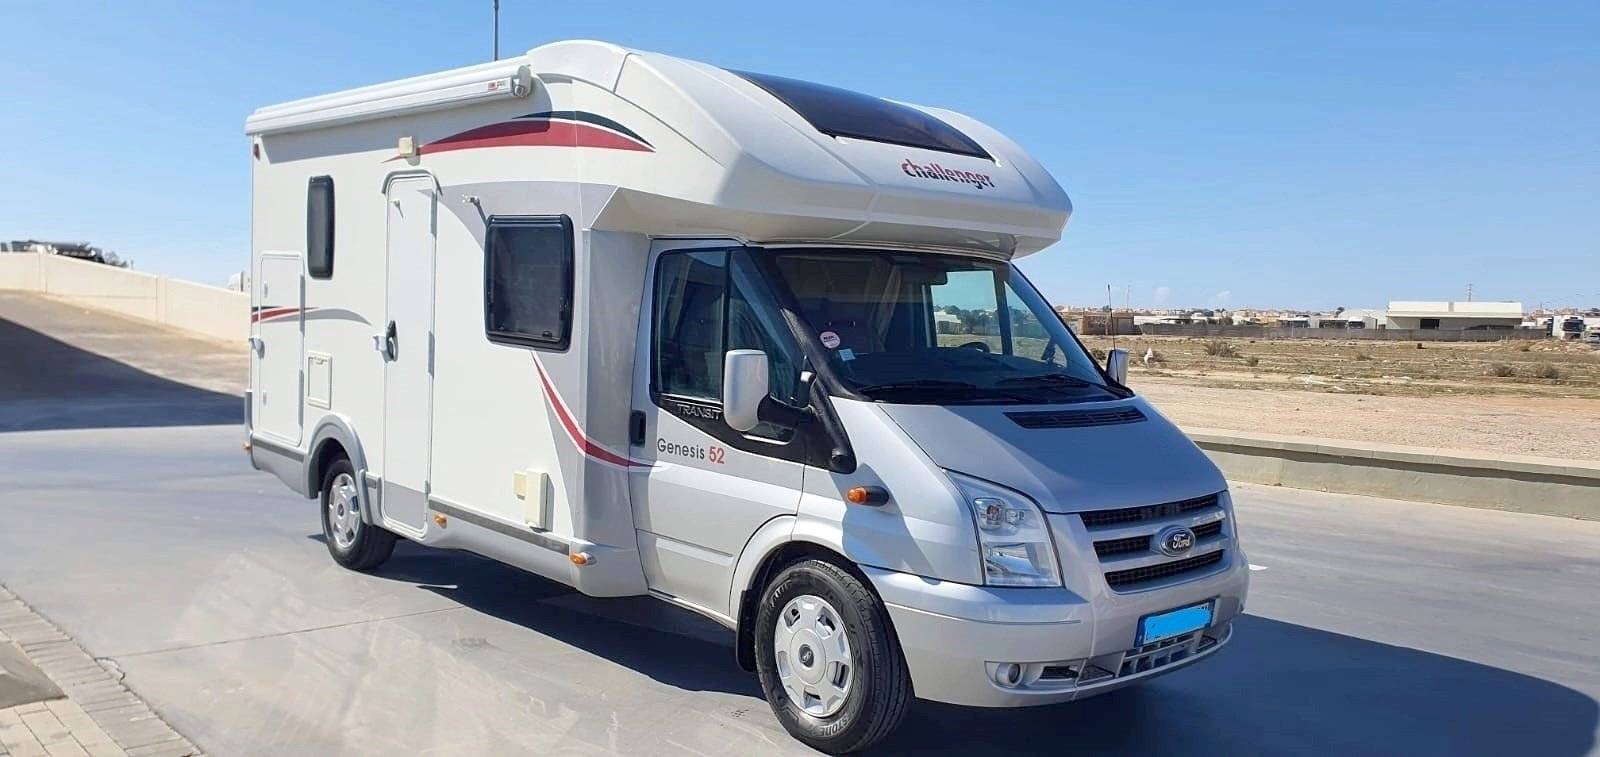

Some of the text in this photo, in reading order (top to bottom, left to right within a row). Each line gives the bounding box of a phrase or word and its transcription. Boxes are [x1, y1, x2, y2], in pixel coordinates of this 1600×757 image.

[901, 158, 995, 190] challenger
[677, 403, 722, 420] TRANSIT
[657, 438, 725, 465] Genesis 52
[1172, 533, 1192, 549] Ford
